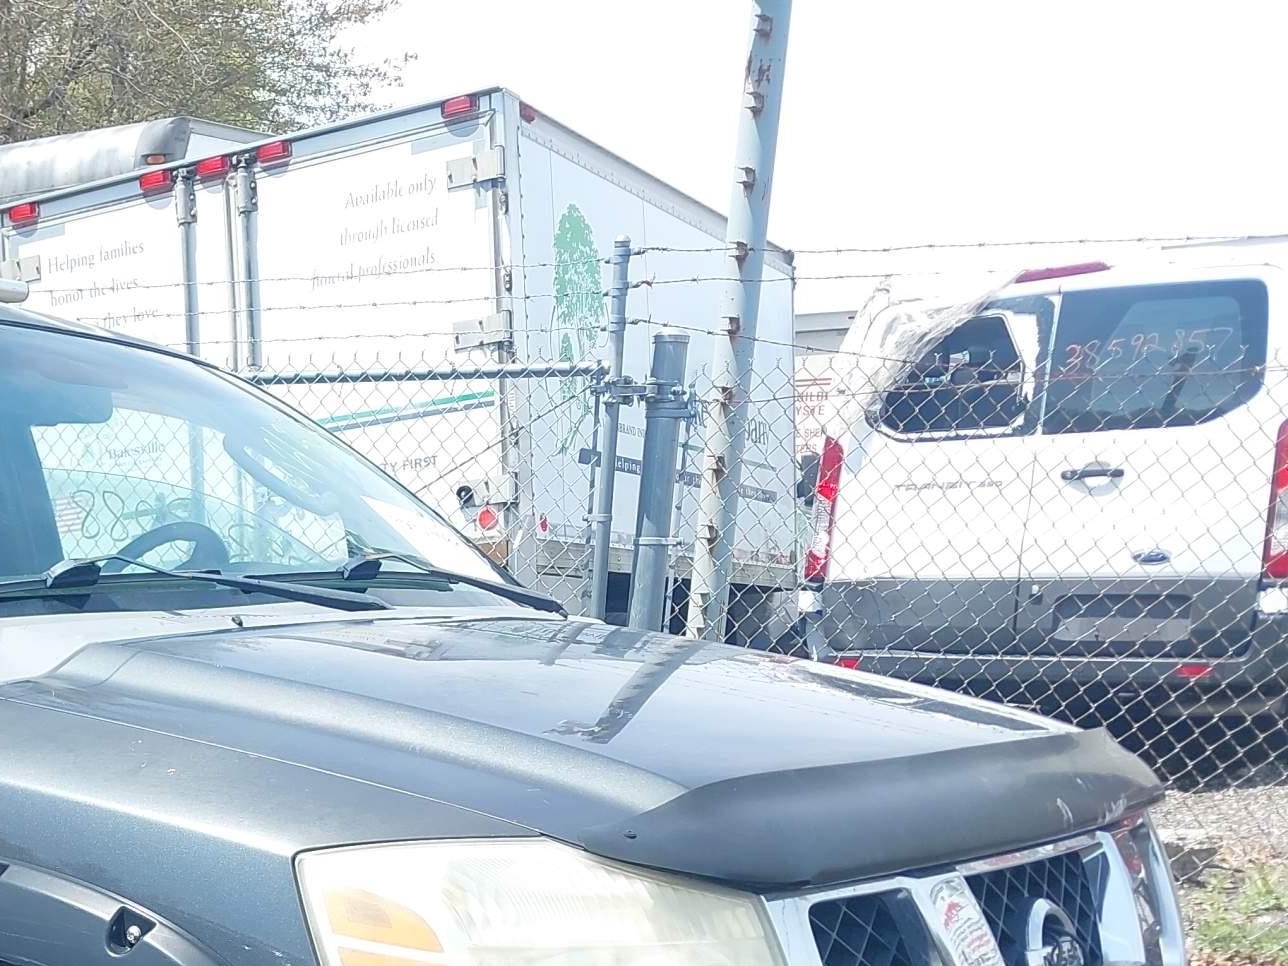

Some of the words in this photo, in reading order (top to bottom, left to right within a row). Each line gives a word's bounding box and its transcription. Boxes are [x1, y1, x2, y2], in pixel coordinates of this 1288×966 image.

[344, 178, 403, 208] Available
[408, 172, 437, 195] only
[338, 218, 388, 247] through
[392, 207, 438, 234] licensed
[48, 254, 95, 274] Helping
[99, 240, 145, 262] families
[357, 246, 436, 284] professionals
[50, 289, 85, 308] honor
[89, 279, 108, 299] the
[112, 277, 139, 294] lives
[402, 455, 438, 471] FIRST
